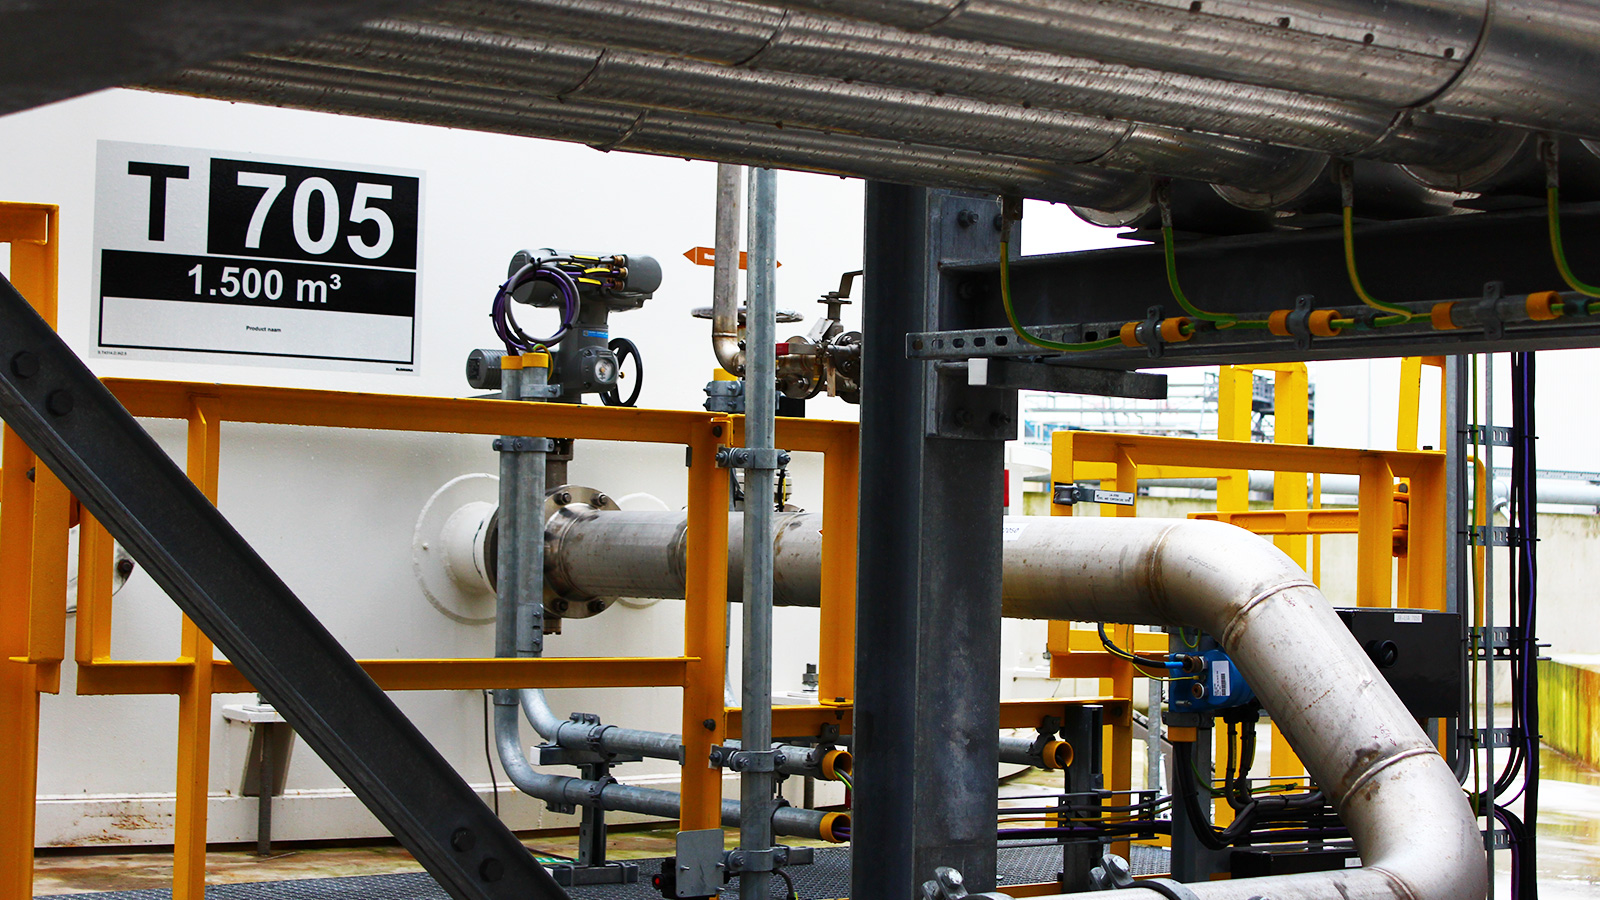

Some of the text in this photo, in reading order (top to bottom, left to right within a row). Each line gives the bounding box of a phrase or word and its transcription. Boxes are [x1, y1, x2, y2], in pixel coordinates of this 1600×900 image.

[127, 160, 394, 260] T 705
[188, 263, 284, 301] 1.500
